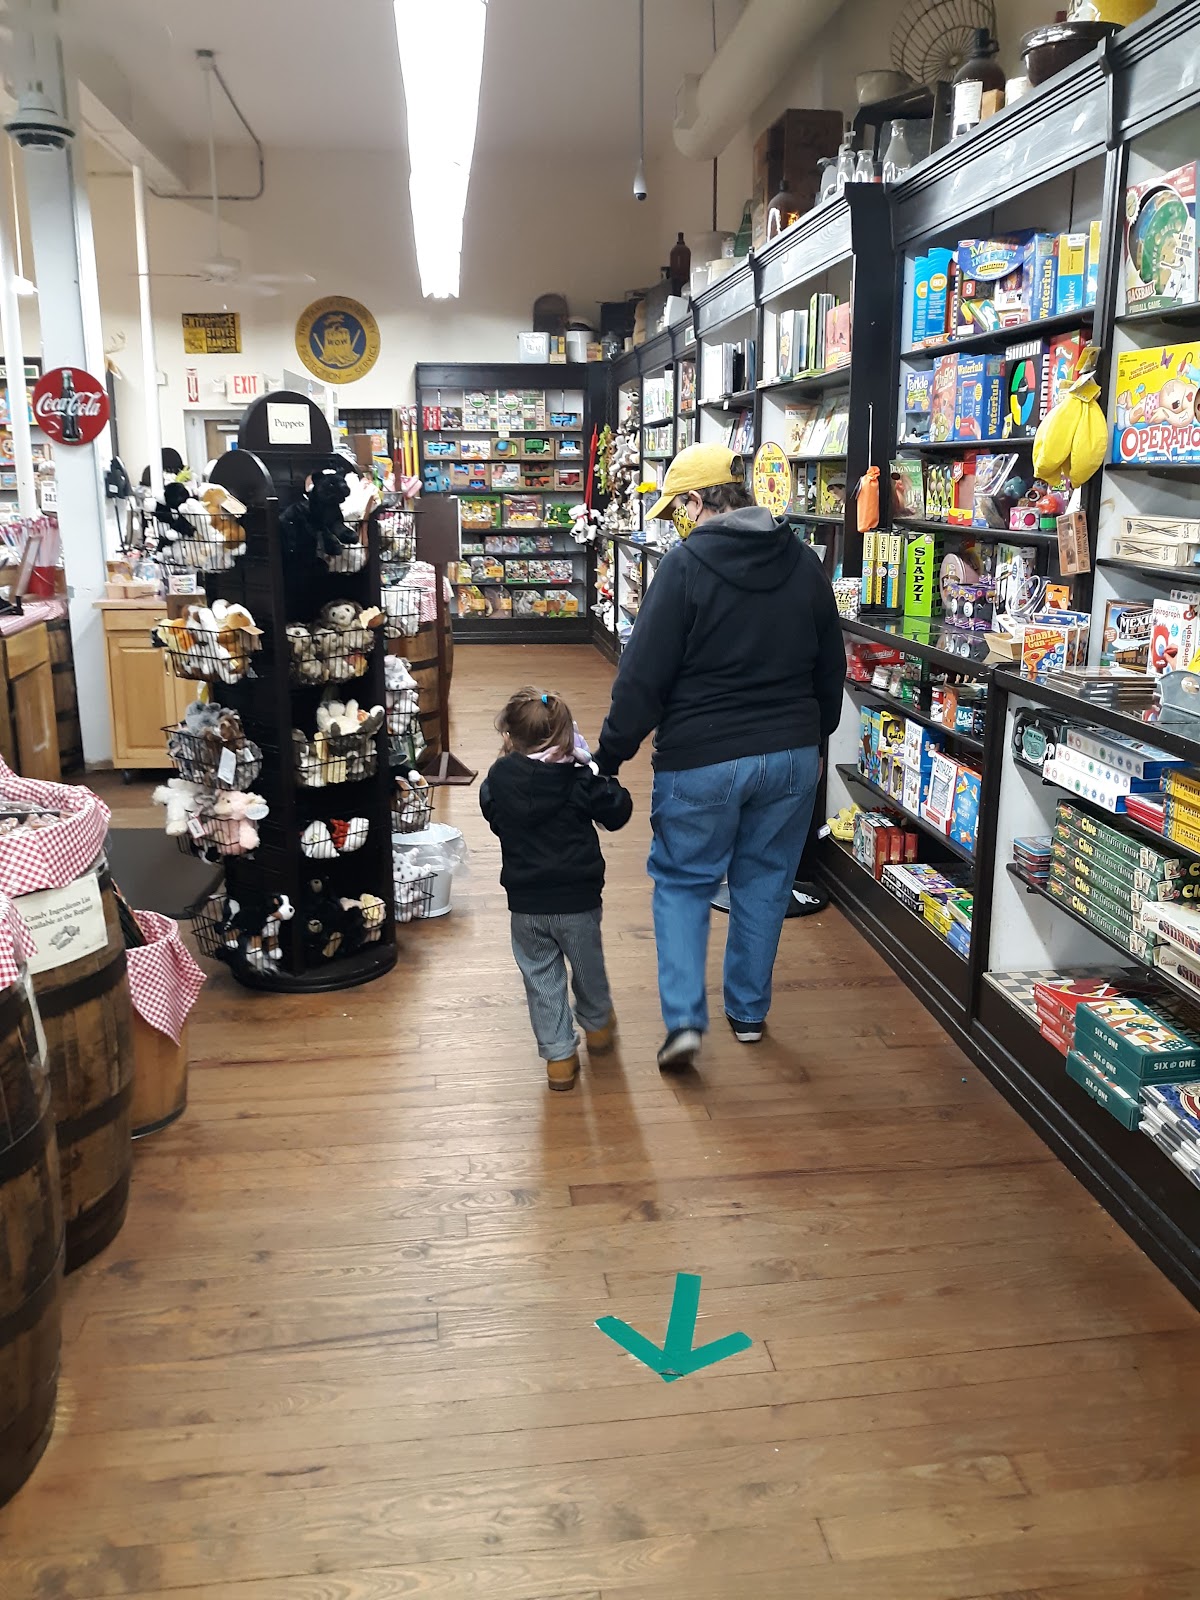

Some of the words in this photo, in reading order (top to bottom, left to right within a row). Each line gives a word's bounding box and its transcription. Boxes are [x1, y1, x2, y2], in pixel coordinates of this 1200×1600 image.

[1040, 259, 1053, 319] Waterfuls
[355, 345, 377, 373] SERVICE
[234, 376, 257, 394] EXIT
[907, 374, 928, 391] Farkle
[988, 379, 999, 435] Waterfuls
[274, 418, 305, 429] Puppets
[913, 547, 926, 602] SLAPZI
[1154, 608, 1181, 619] spirograph
[1025, 630, 1059, 643] BUBBLE
[1183, 624, 1192, 666] spirograph
[1081, 817, 1097, 836] Clue
[1106, 835, 1121, 851] Classic
[1122, 843, 1139, 860] Edition
[1074, 857, 1090, 876] Clue
[1078, 837, 1093, 856] Clue
[1101, 854, 1117, 870] Classic
[1117, 866, 1134, 880] Edition
[24, 911, 47, 922] Candy
[48, 901, 81, 916] Ingredients
[81, 896, 91, 904] List
[73, 904, 93, 916] Register
[1075, 876, 1090, 895] Clue
[1099, 895, 1115, 911] Classic
[1115, 905, 1132, 922] Edition
[1072, 895, 1087, 915] Clue
[1096, 915, 1111, 931] Classic
[1112, 926, 1129, 943] Edition
[1094, 1027, 1103, 1039] SIX
[1108, 1037, 1119, 1051] ONE
[1093, 1051, 1101, 1063] SIX
[1106, 1062, 1117, 1075] ONE
[1154, 1062, 1168, 1070] SIX
[1179, 1060, 1196, 1068] ONE
[1085, 1077, 1093, 1090] SIX
[1097, 1089, 1109, 1103] ONE
